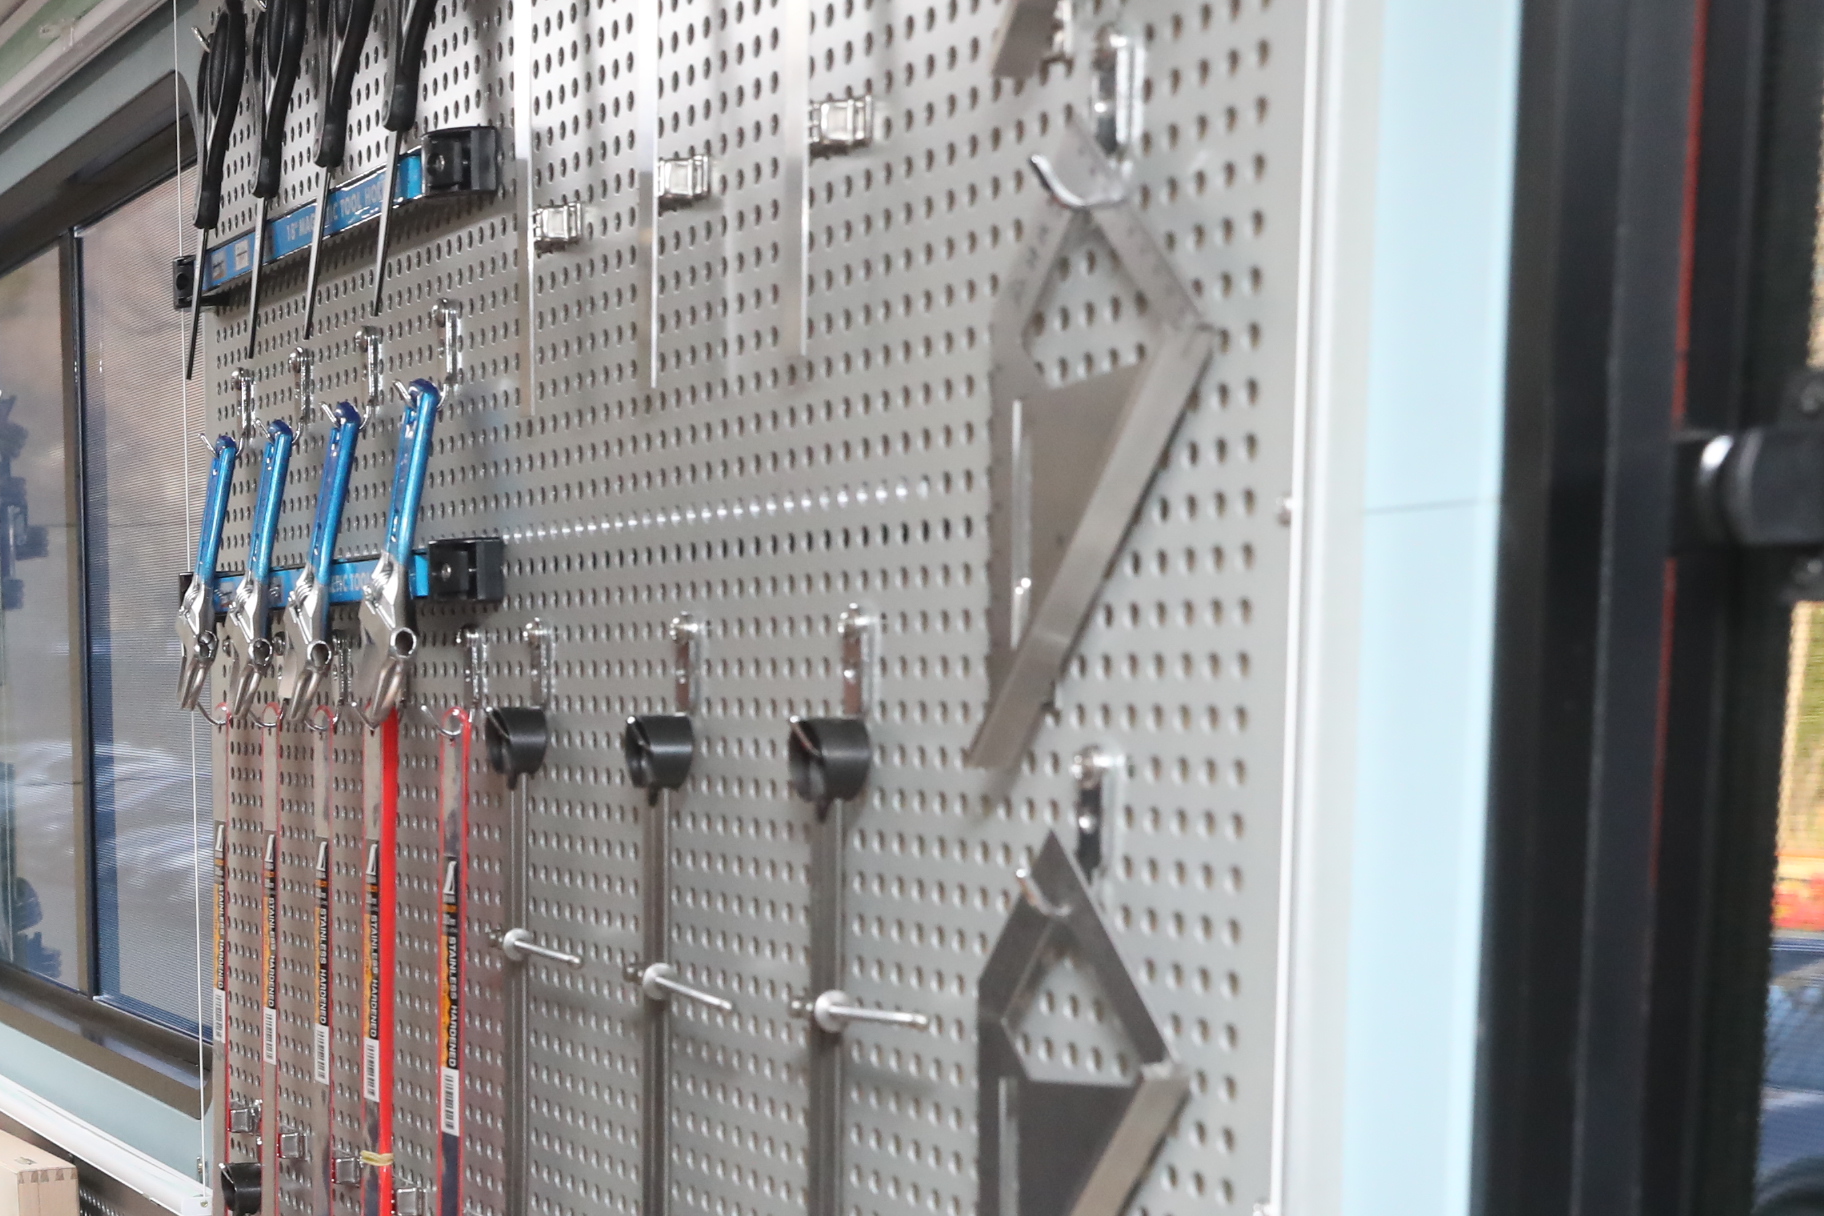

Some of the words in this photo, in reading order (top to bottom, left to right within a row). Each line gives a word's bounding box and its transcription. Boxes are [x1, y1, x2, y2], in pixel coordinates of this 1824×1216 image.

[371, 914, 379, 974] STAINLESS
[448, 935, 457, 1000] STAINLESS
[268, 955, 276, 1008] HARDENED
[319, 969, 327, 1024] HARDENED
[370, 979, 379, 1038] HARDENED
[448, 1004, 458, 1067] HARDENED
